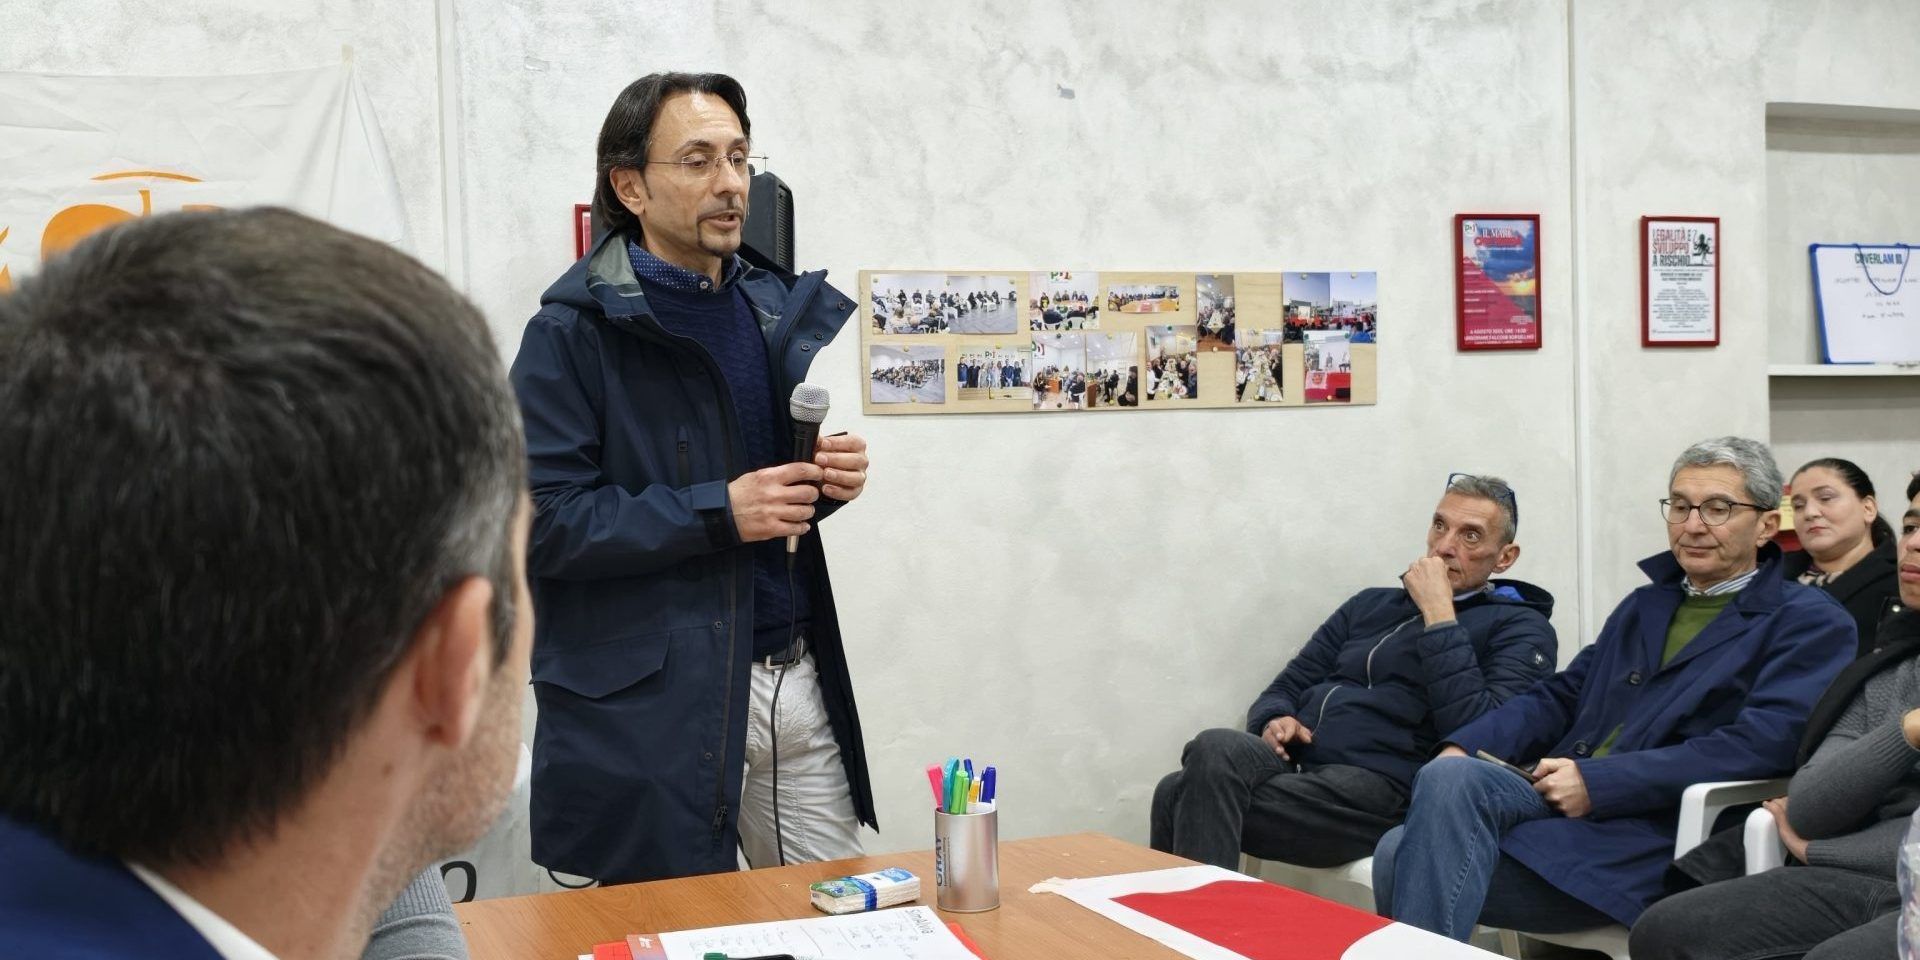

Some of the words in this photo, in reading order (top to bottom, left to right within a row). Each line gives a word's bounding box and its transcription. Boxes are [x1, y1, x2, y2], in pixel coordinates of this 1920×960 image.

[1652, 227, 1686, 241] LEGALITÀ
[1652, 240, 1689, 254] SVILUPPO
[1660, 254, 1691, 267] RISCHIO
